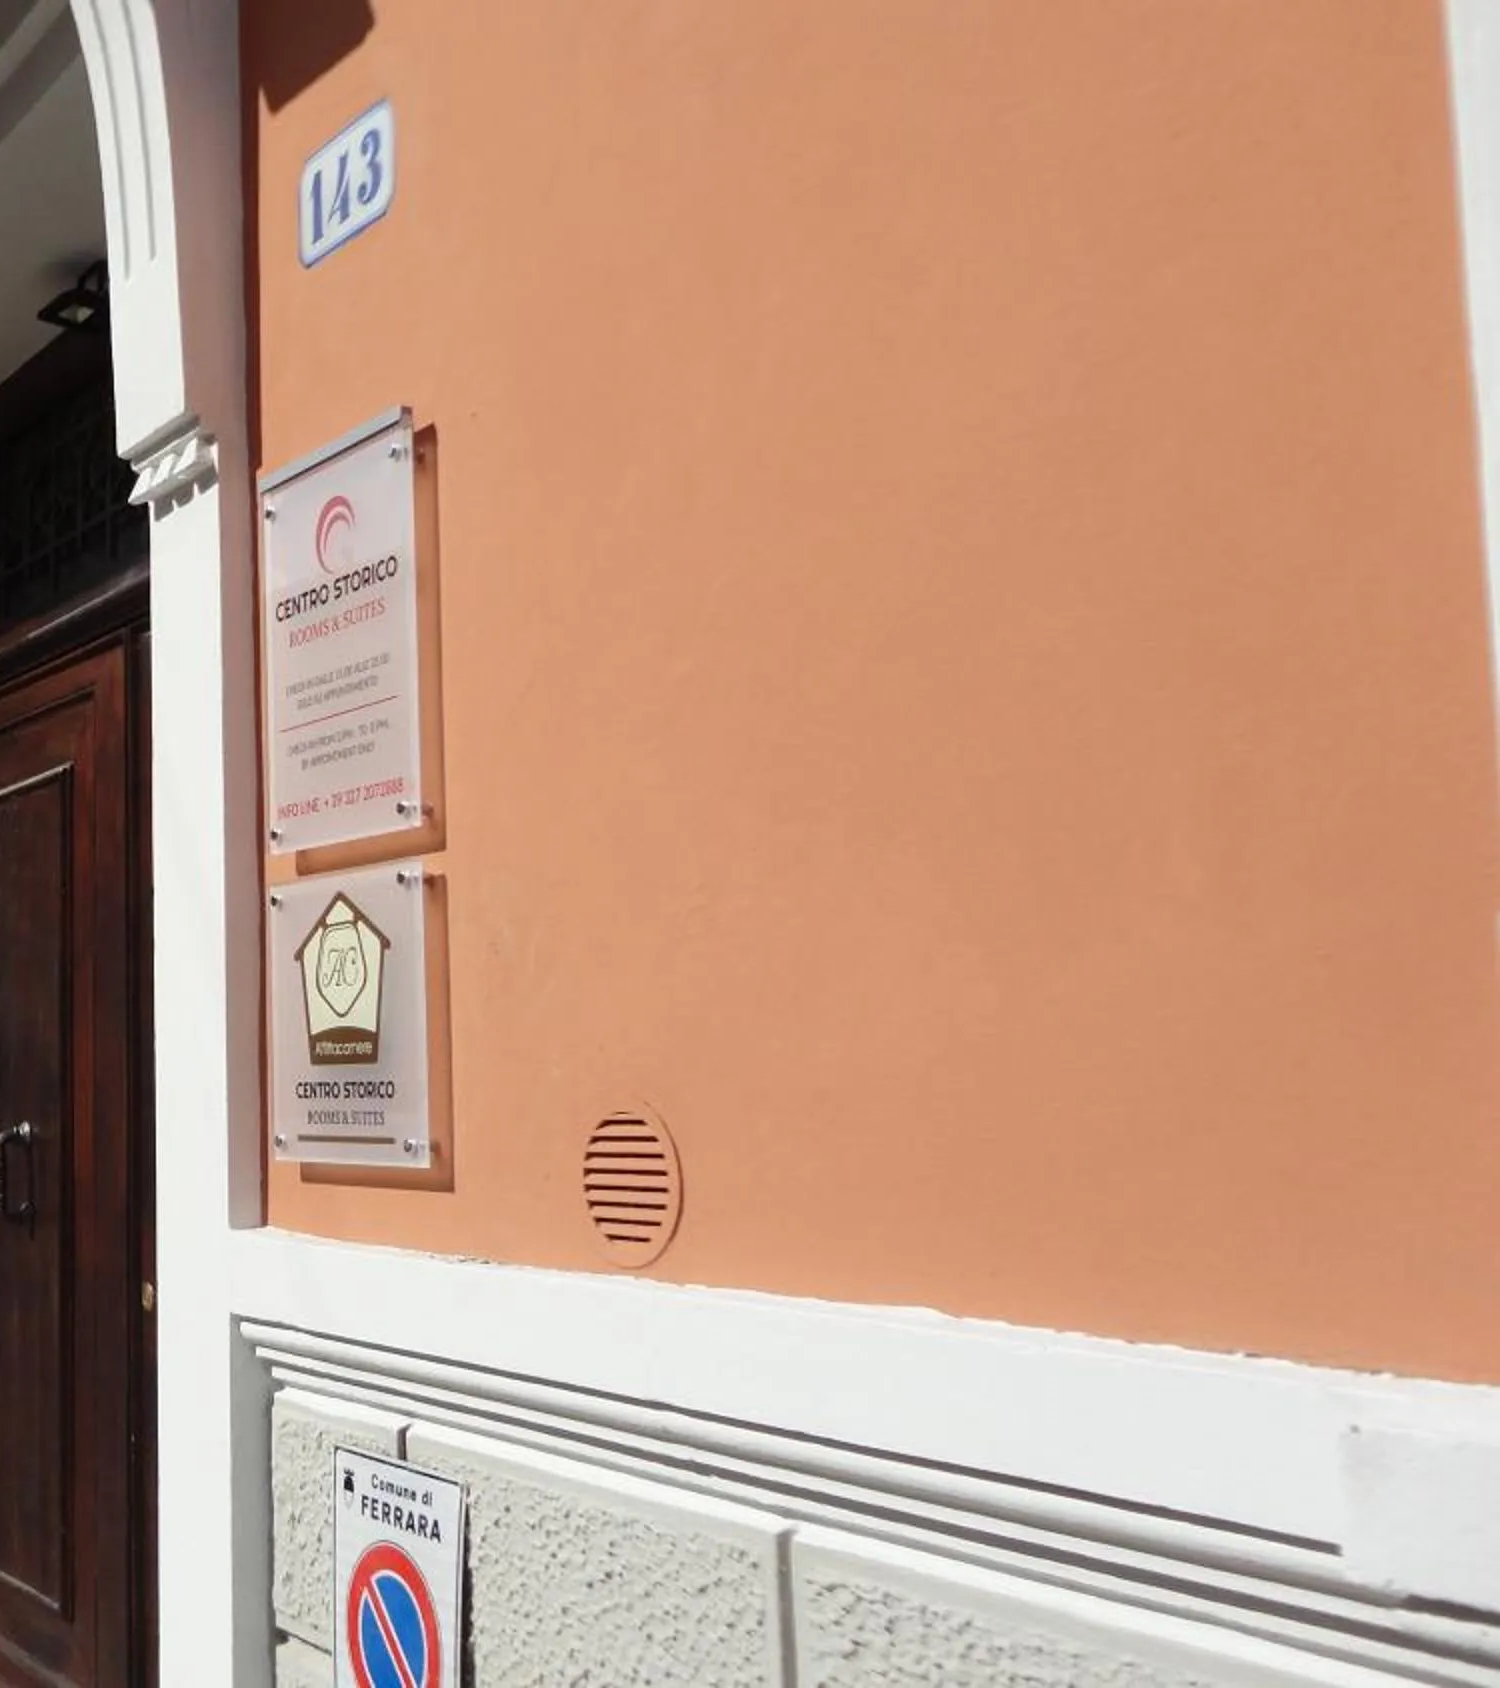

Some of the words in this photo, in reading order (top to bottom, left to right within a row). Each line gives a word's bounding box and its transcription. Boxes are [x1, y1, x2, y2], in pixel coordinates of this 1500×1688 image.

[310, 128, 383, 245] 143
[275, 584, 330, 622] CENTRO
[333, 555, 398, 601] STORICO
[289, 618, 329, 648] ROOMS
[332, 617, 340, 633] &
[342, 599, 386, 628] SUITES
[295, 1081, 341, 1099] CENTRO
[343, 1080, 395, 1099] STORICO
[307, 1109, 340, 1125] ROOMS
[350, 1109, 385, 1125] SUITES
[371, 1473, 417, 1501] Comune
[421, 1490, 433, 1508] di
[361, 1494, 442, 1543] FERRARA
